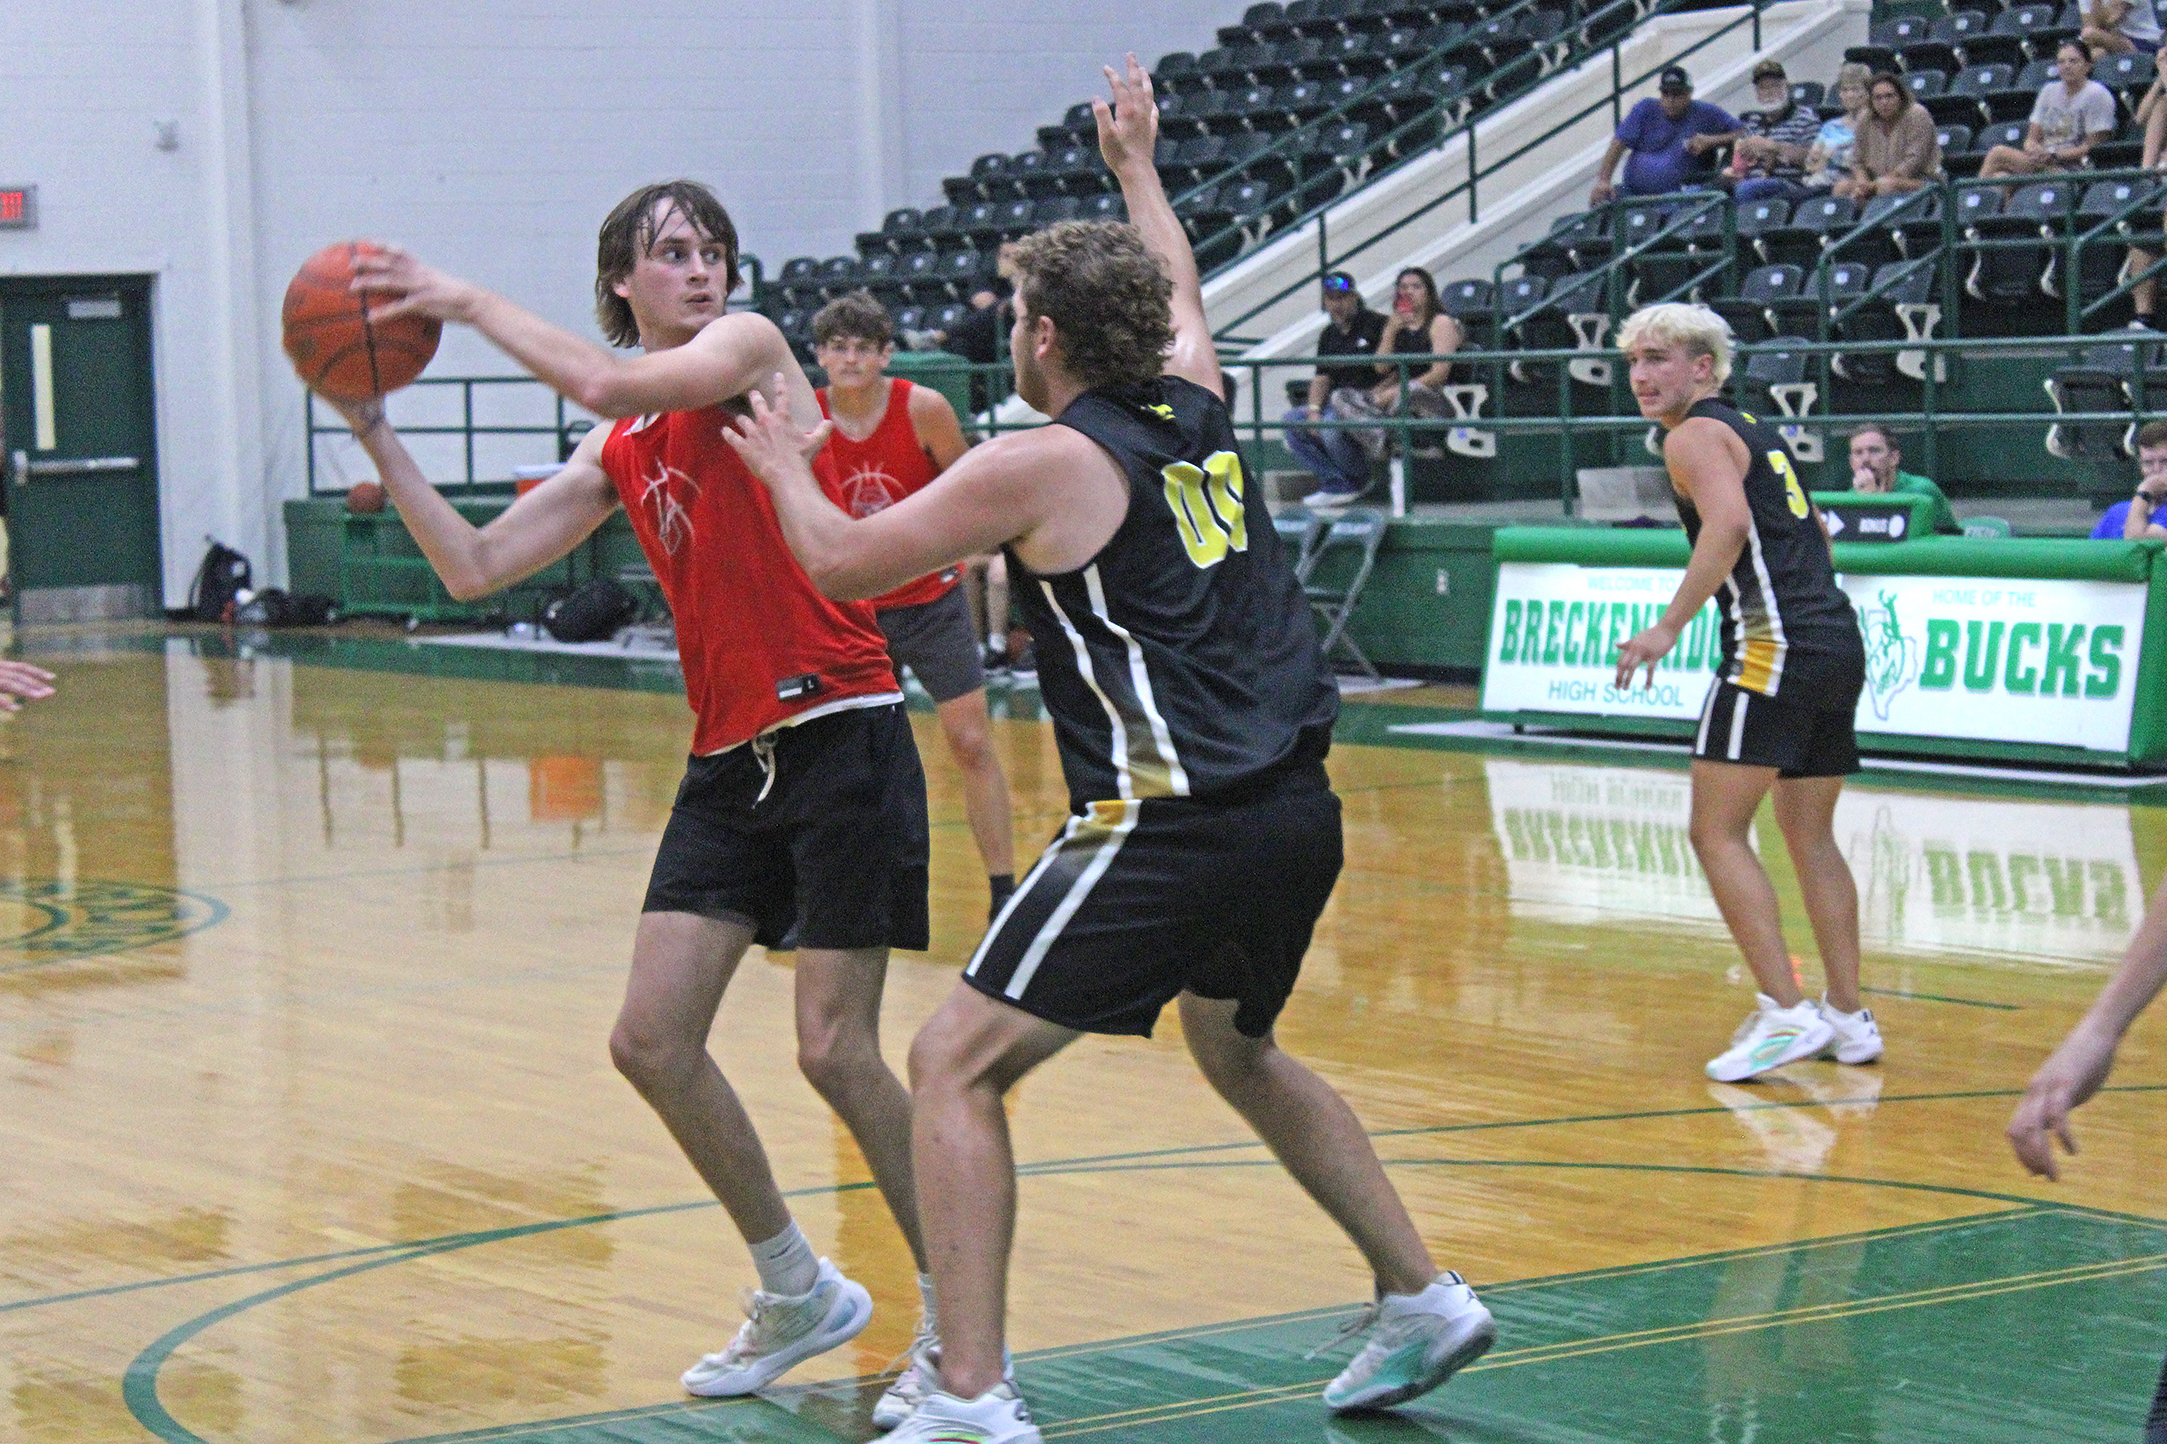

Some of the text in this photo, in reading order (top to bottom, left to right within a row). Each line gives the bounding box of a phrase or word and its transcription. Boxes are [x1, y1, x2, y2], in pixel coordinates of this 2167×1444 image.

[1767, 450, 1809, 519] 3
[1587, 575, 1676, 593] WELCOME TO
[1932, 588, 2037, 608] HOME OF THE
[1918, 618, 2125, 700] BUCKS
[1548, 680, 1684, 708] HIGH SCHOOL
